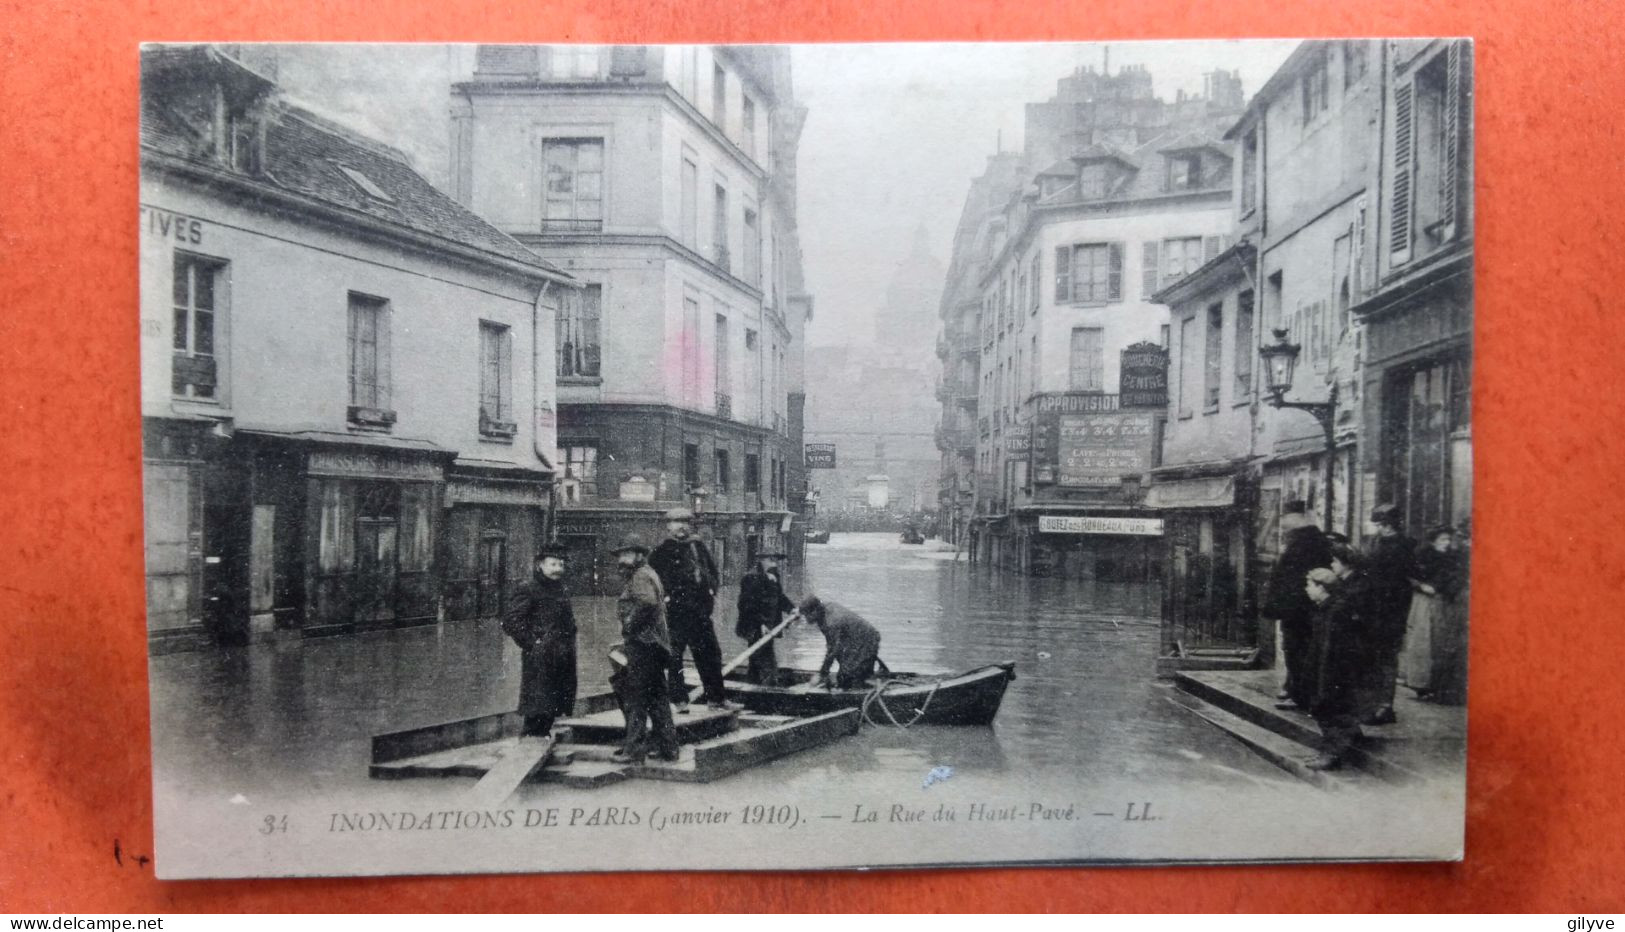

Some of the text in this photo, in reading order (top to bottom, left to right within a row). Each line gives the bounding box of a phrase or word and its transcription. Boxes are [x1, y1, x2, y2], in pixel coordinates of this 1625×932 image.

[1038, 396, 1120, 411] APPROVISION
[1006, 439, 1029, 449] VINS
[258, 814, 289, 835] 34
[328, 809, 515, 833] INONDATIONS
[523, 807, 560, 828] DE
[568, 806, 642, 827] PARIS
[740, 804, 807, 830] 1910).
[851, 803, 879, 824] La
[889, 803, 926, 823] Rue
[931, 803, 957, 822] du
[967, 802, 1081, 823] Haut-Pavé.
[1124, 801, 1163, 822] LL.
